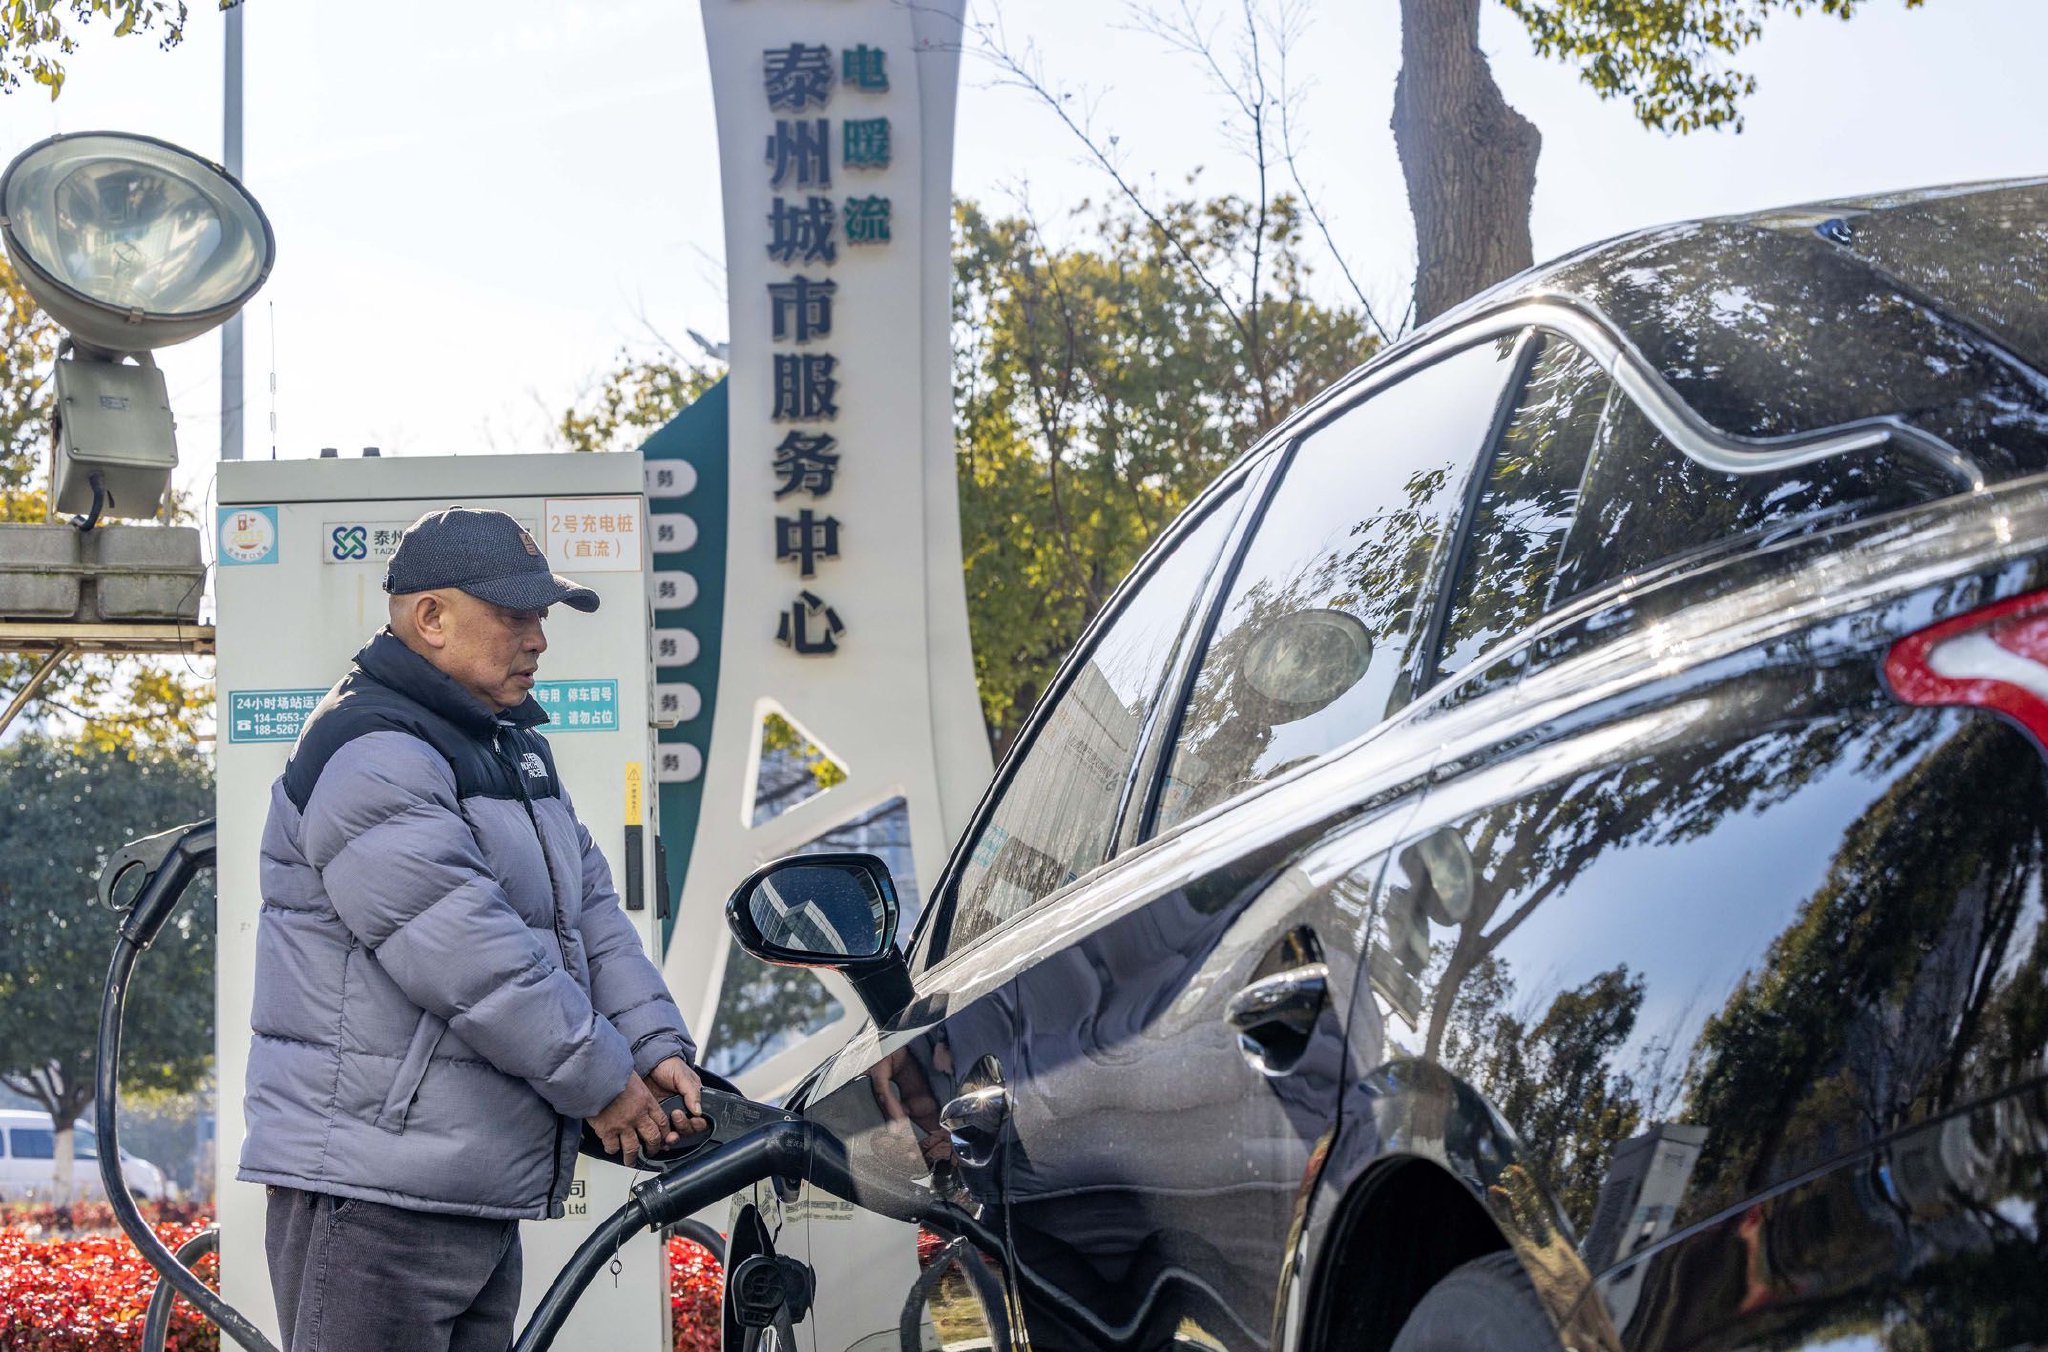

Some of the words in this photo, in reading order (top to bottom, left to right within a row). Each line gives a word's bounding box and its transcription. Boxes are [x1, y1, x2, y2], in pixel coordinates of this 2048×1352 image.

[842, 44, 891, 246] 电暖流
[763, 43, 845, 656] 泰州城市服务中心
[551, 514, 634, 533] 2号充电桩
[568, 687, 612, 702] 停车留号
[546, 711, 560, 725] 走
[568, 709, 613, 725] 请勿占位
[568, 1203, 586, 1214] Ltd
